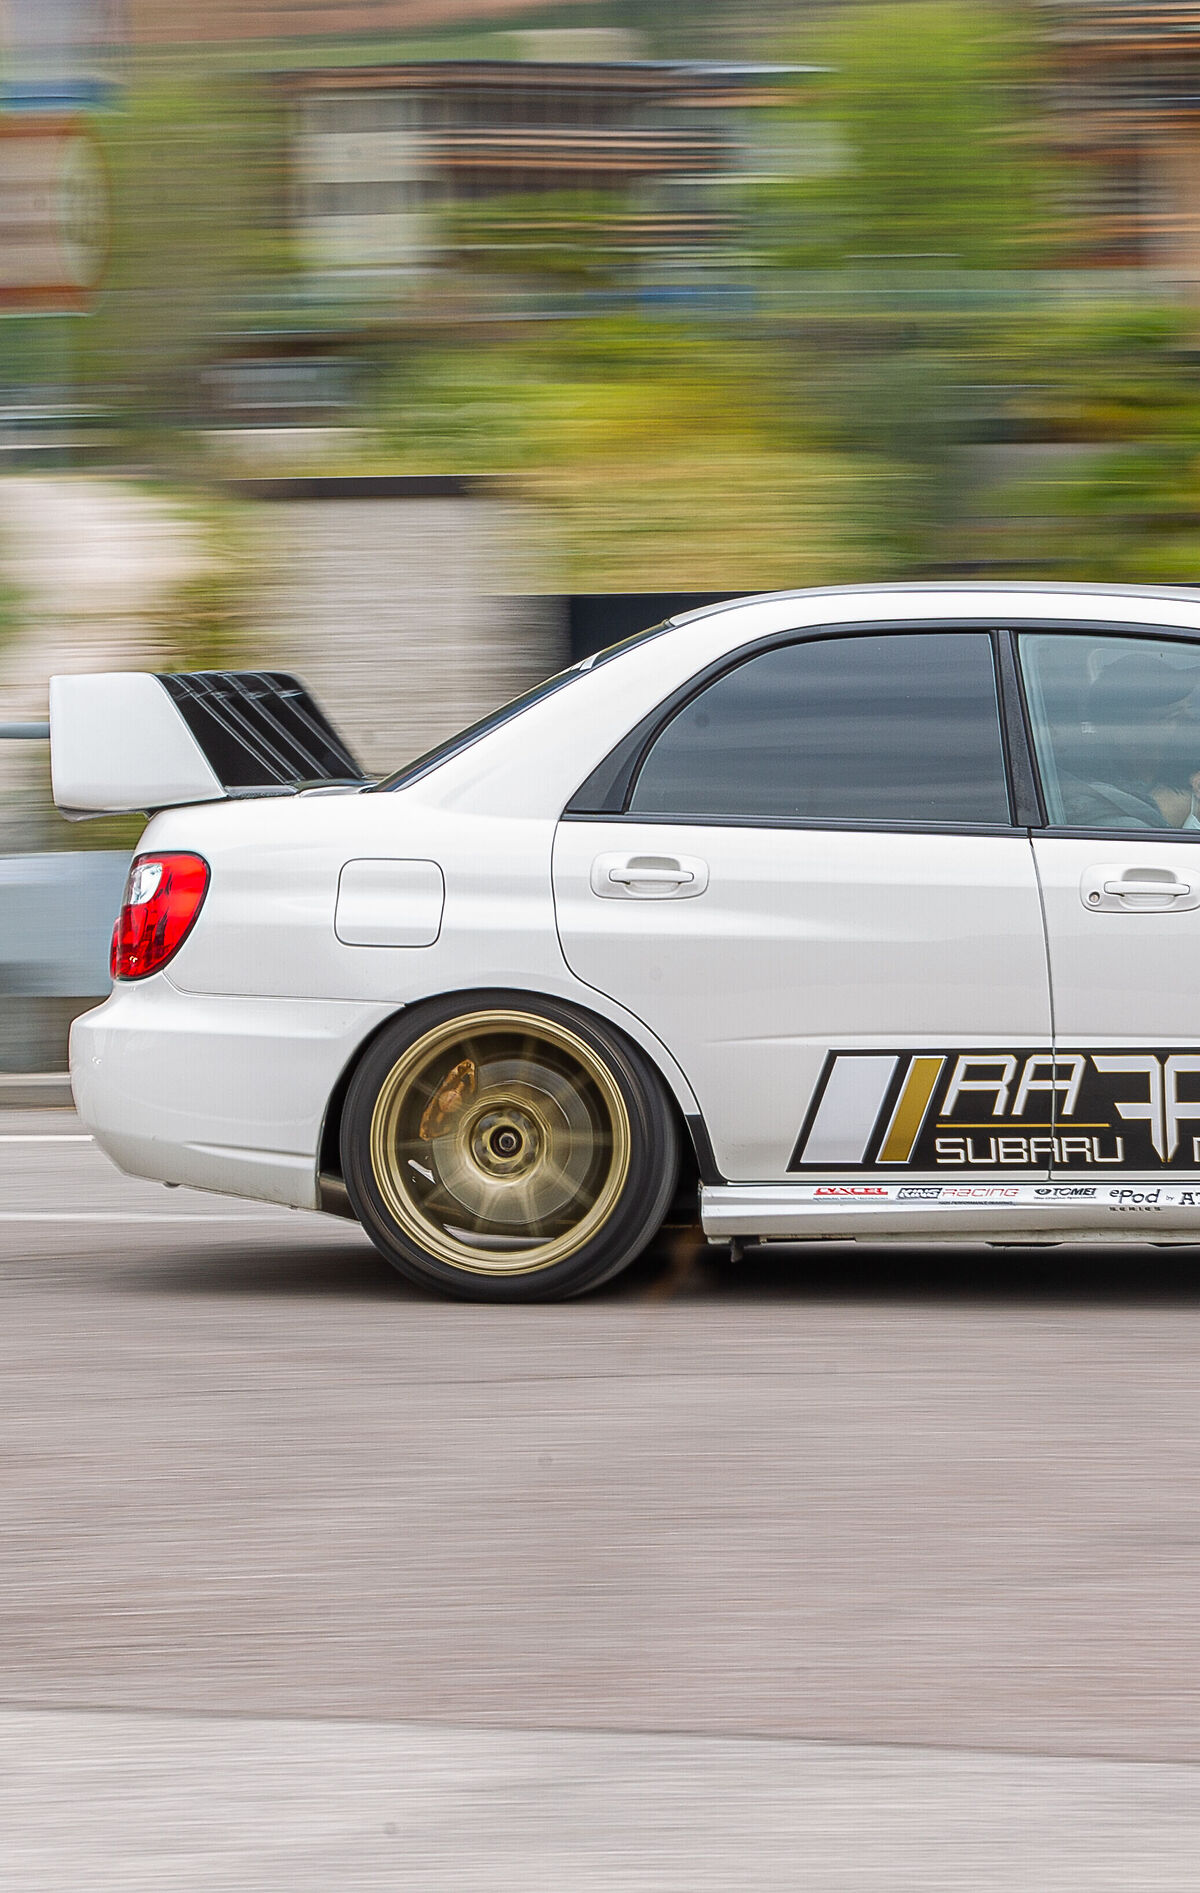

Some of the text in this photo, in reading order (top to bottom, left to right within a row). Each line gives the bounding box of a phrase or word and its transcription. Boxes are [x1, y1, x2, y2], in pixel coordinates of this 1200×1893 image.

[935, 1137, 1123, 1163] SUBARU
[1052, 1187, 1097, 1196] TOMEI
[1109, 1188, 1161, 1204] ePod
